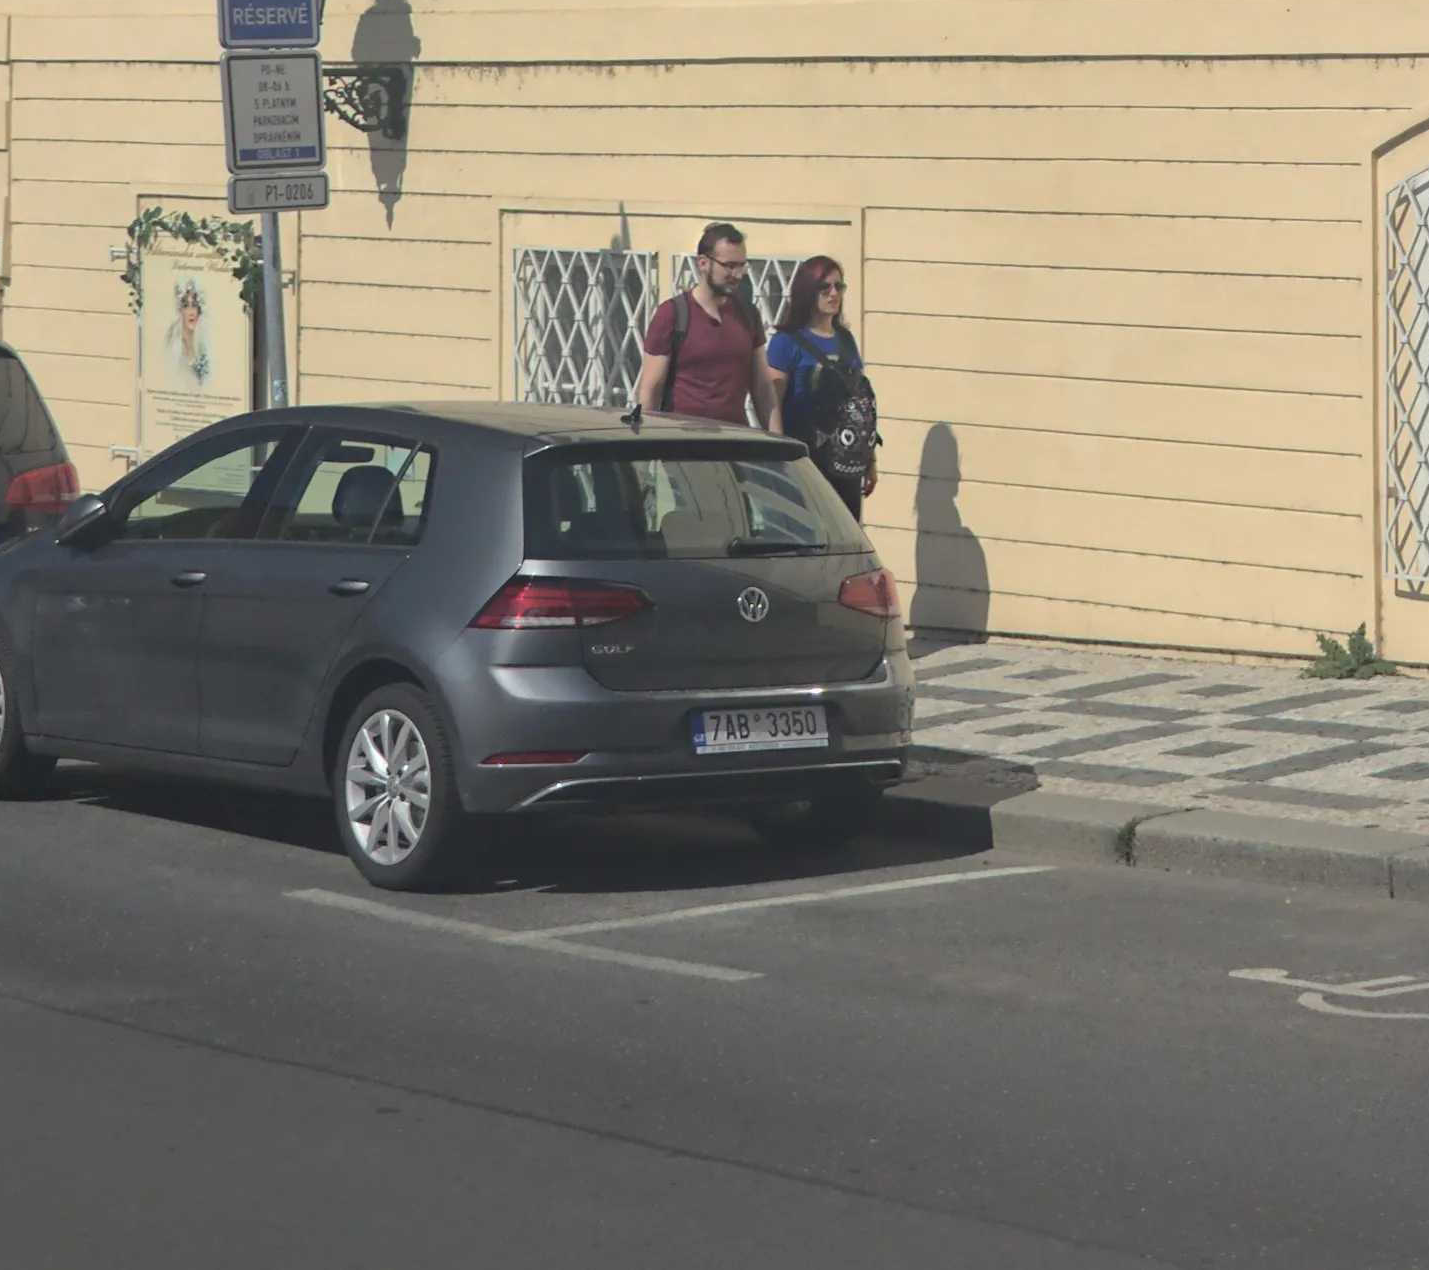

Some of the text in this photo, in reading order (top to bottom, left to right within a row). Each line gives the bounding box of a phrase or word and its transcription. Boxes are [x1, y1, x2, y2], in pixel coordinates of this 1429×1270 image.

[233, 2, 309, 25] RÉSERVÉ
[256, 148, 292, 160] OBLAST
[265, 183, 314, 201] P1-0206
[591, 644, 634, 654] GOLF
[709, 713, 750, 741] 7AB
[765, 710, 818, 738] 3350
